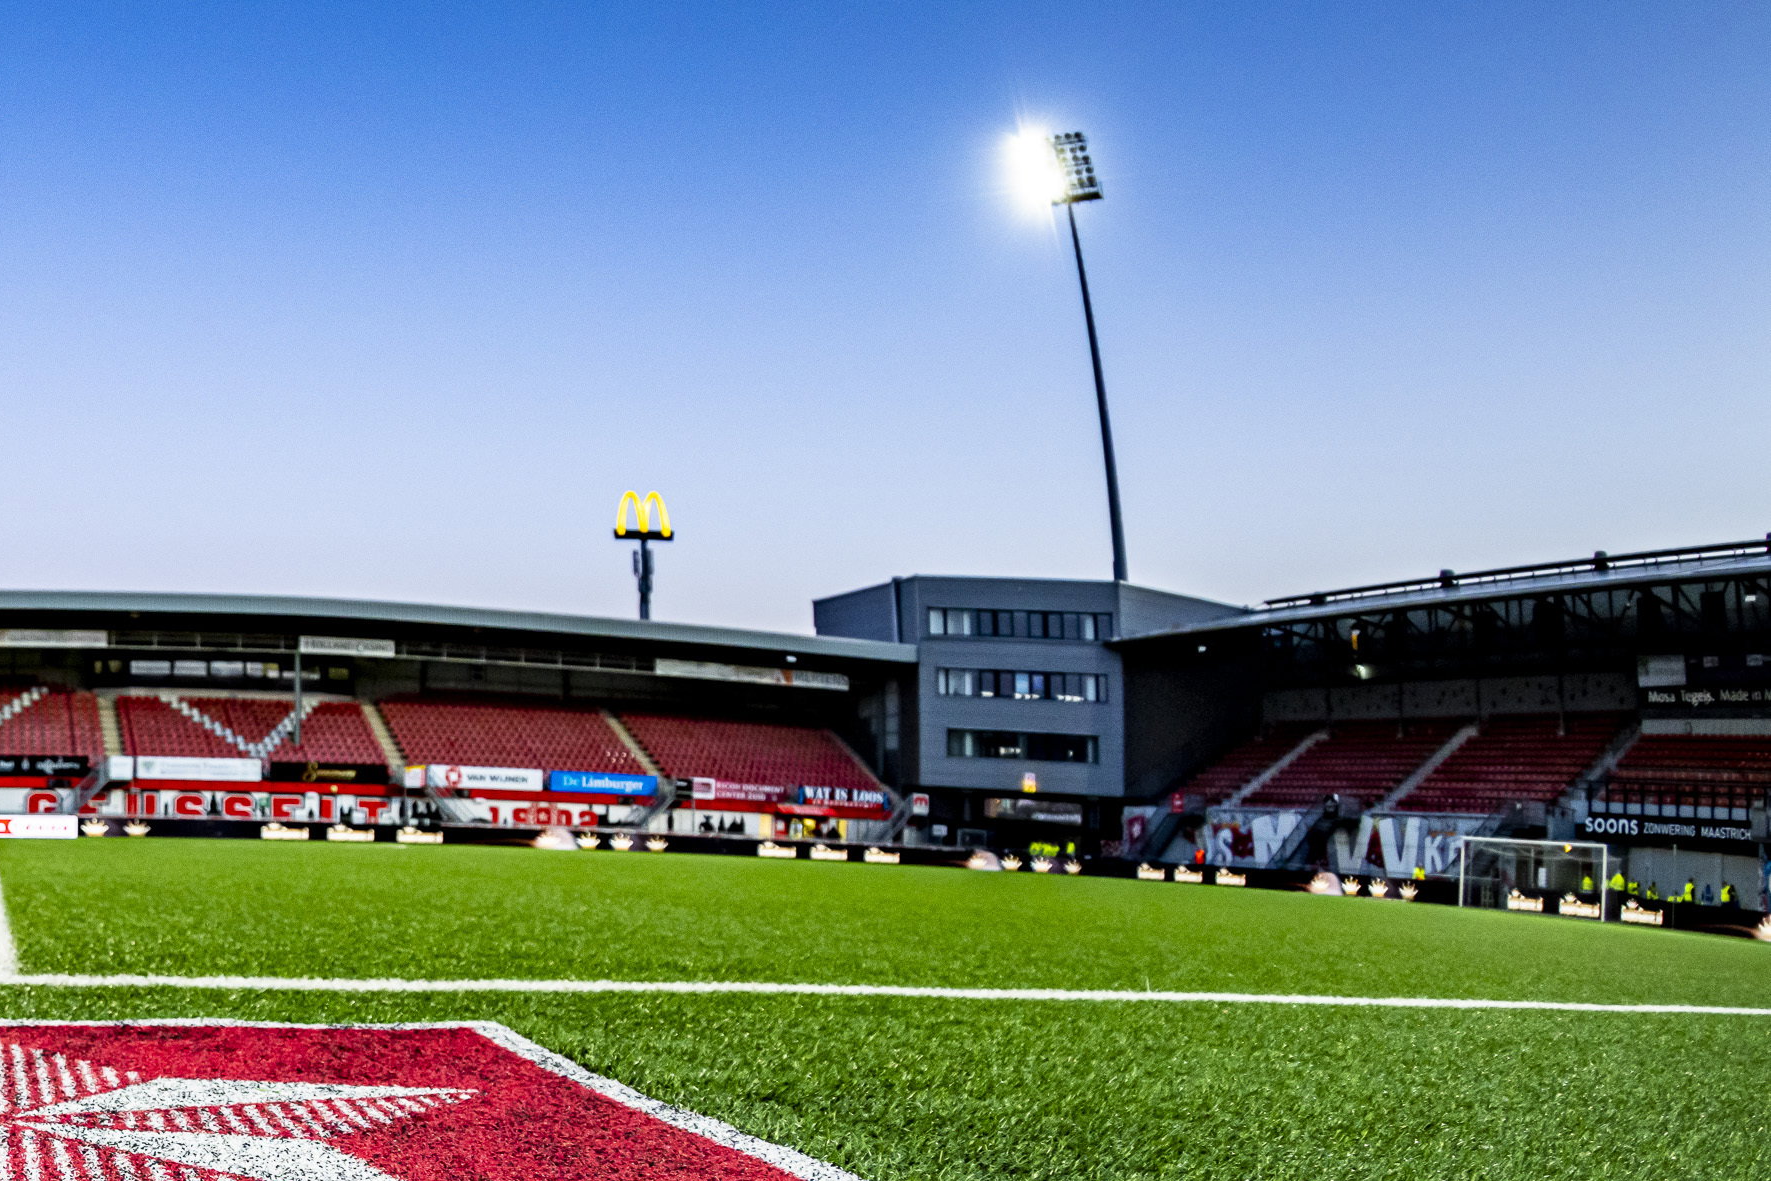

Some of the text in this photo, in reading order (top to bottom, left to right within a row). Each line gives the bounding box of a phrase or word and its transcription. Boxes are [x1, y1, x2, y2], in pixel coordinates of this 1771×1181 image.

[581, 776, 644, 792] Limburger
[1585, 817, 1752, 840] soons ZONWERING MAASTRICH
